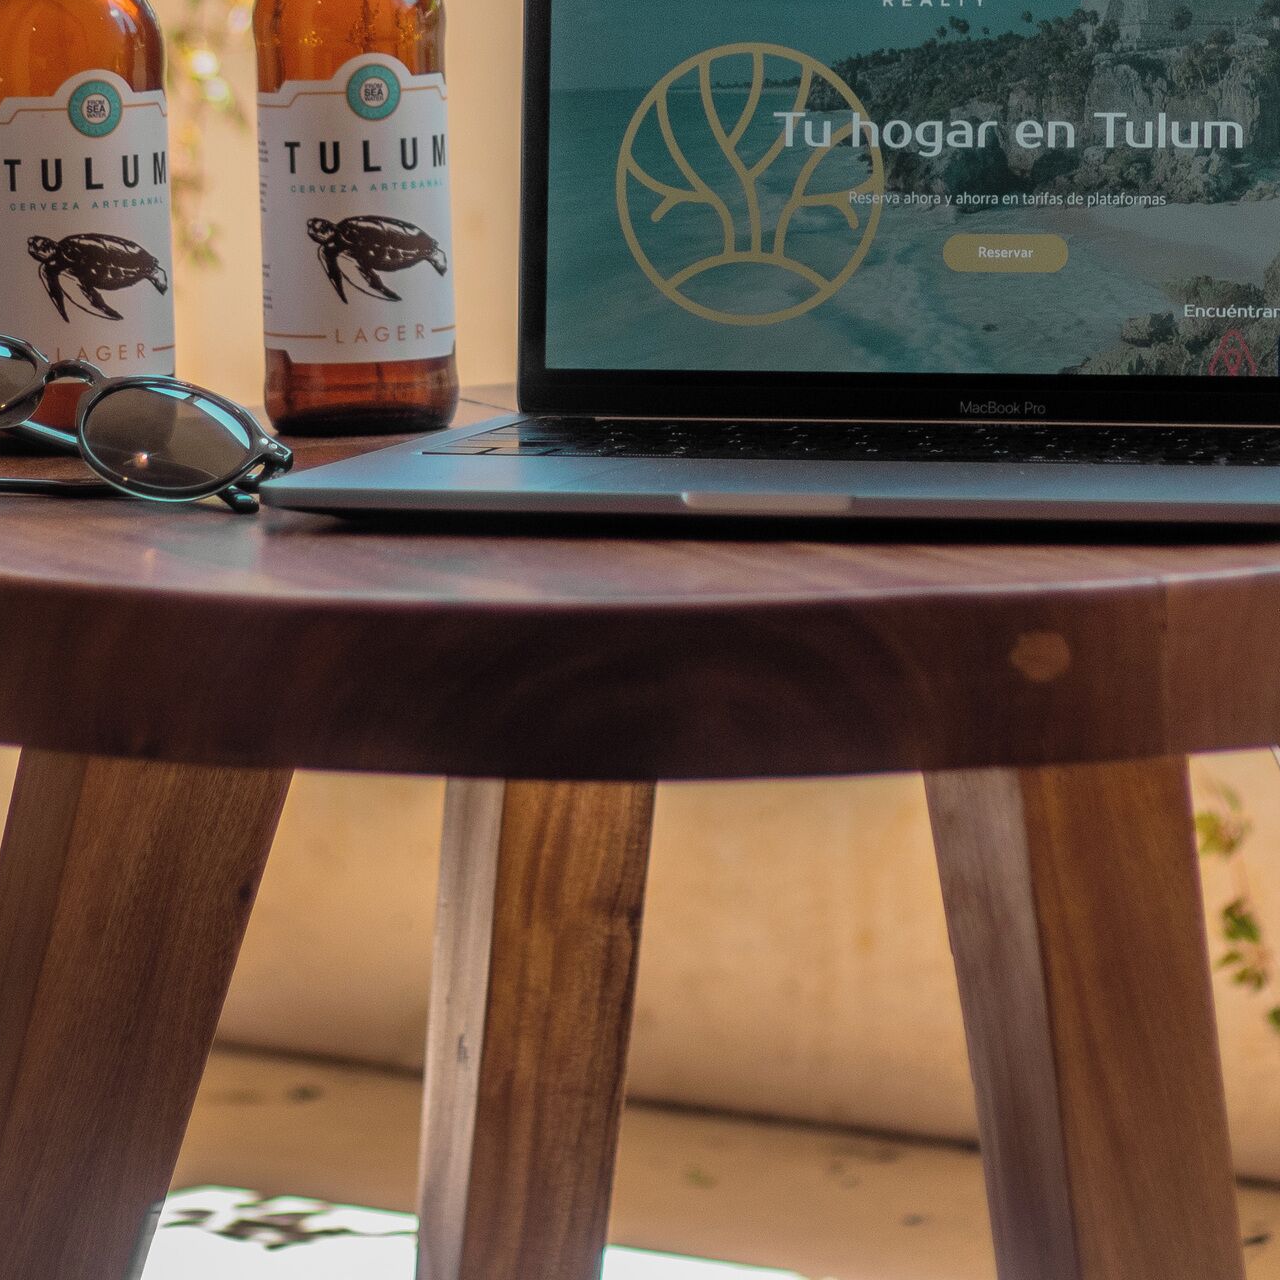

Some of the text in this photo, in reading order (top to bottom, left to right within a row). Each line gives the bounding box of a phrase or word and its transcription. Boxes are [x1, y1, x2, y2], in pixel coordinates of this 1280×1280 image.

[364, 88, 383, 97] SEA
[86, 105, 106, 114] SEA
[773, 111, 1245, 158] Tu hogar en Tulum
[284, 133, 447, 175] TULUM
[3, 150, 167, 193] TULUM
[290, 179, 444, 194] CERVEZA ARTESANAL
[9, 198, 164, 212] CERVEZA ARTESANAL
[848, 191, 1167, 209] Reserva ahora y ahorra en tarifas de plataformas
[978, 246, 1034, 260] Reservar
[335, 323, 425, 344] LAGER
[56, 343, 146, 362] LAGER
[960, 401, 1047, 415] MacBook Pro
